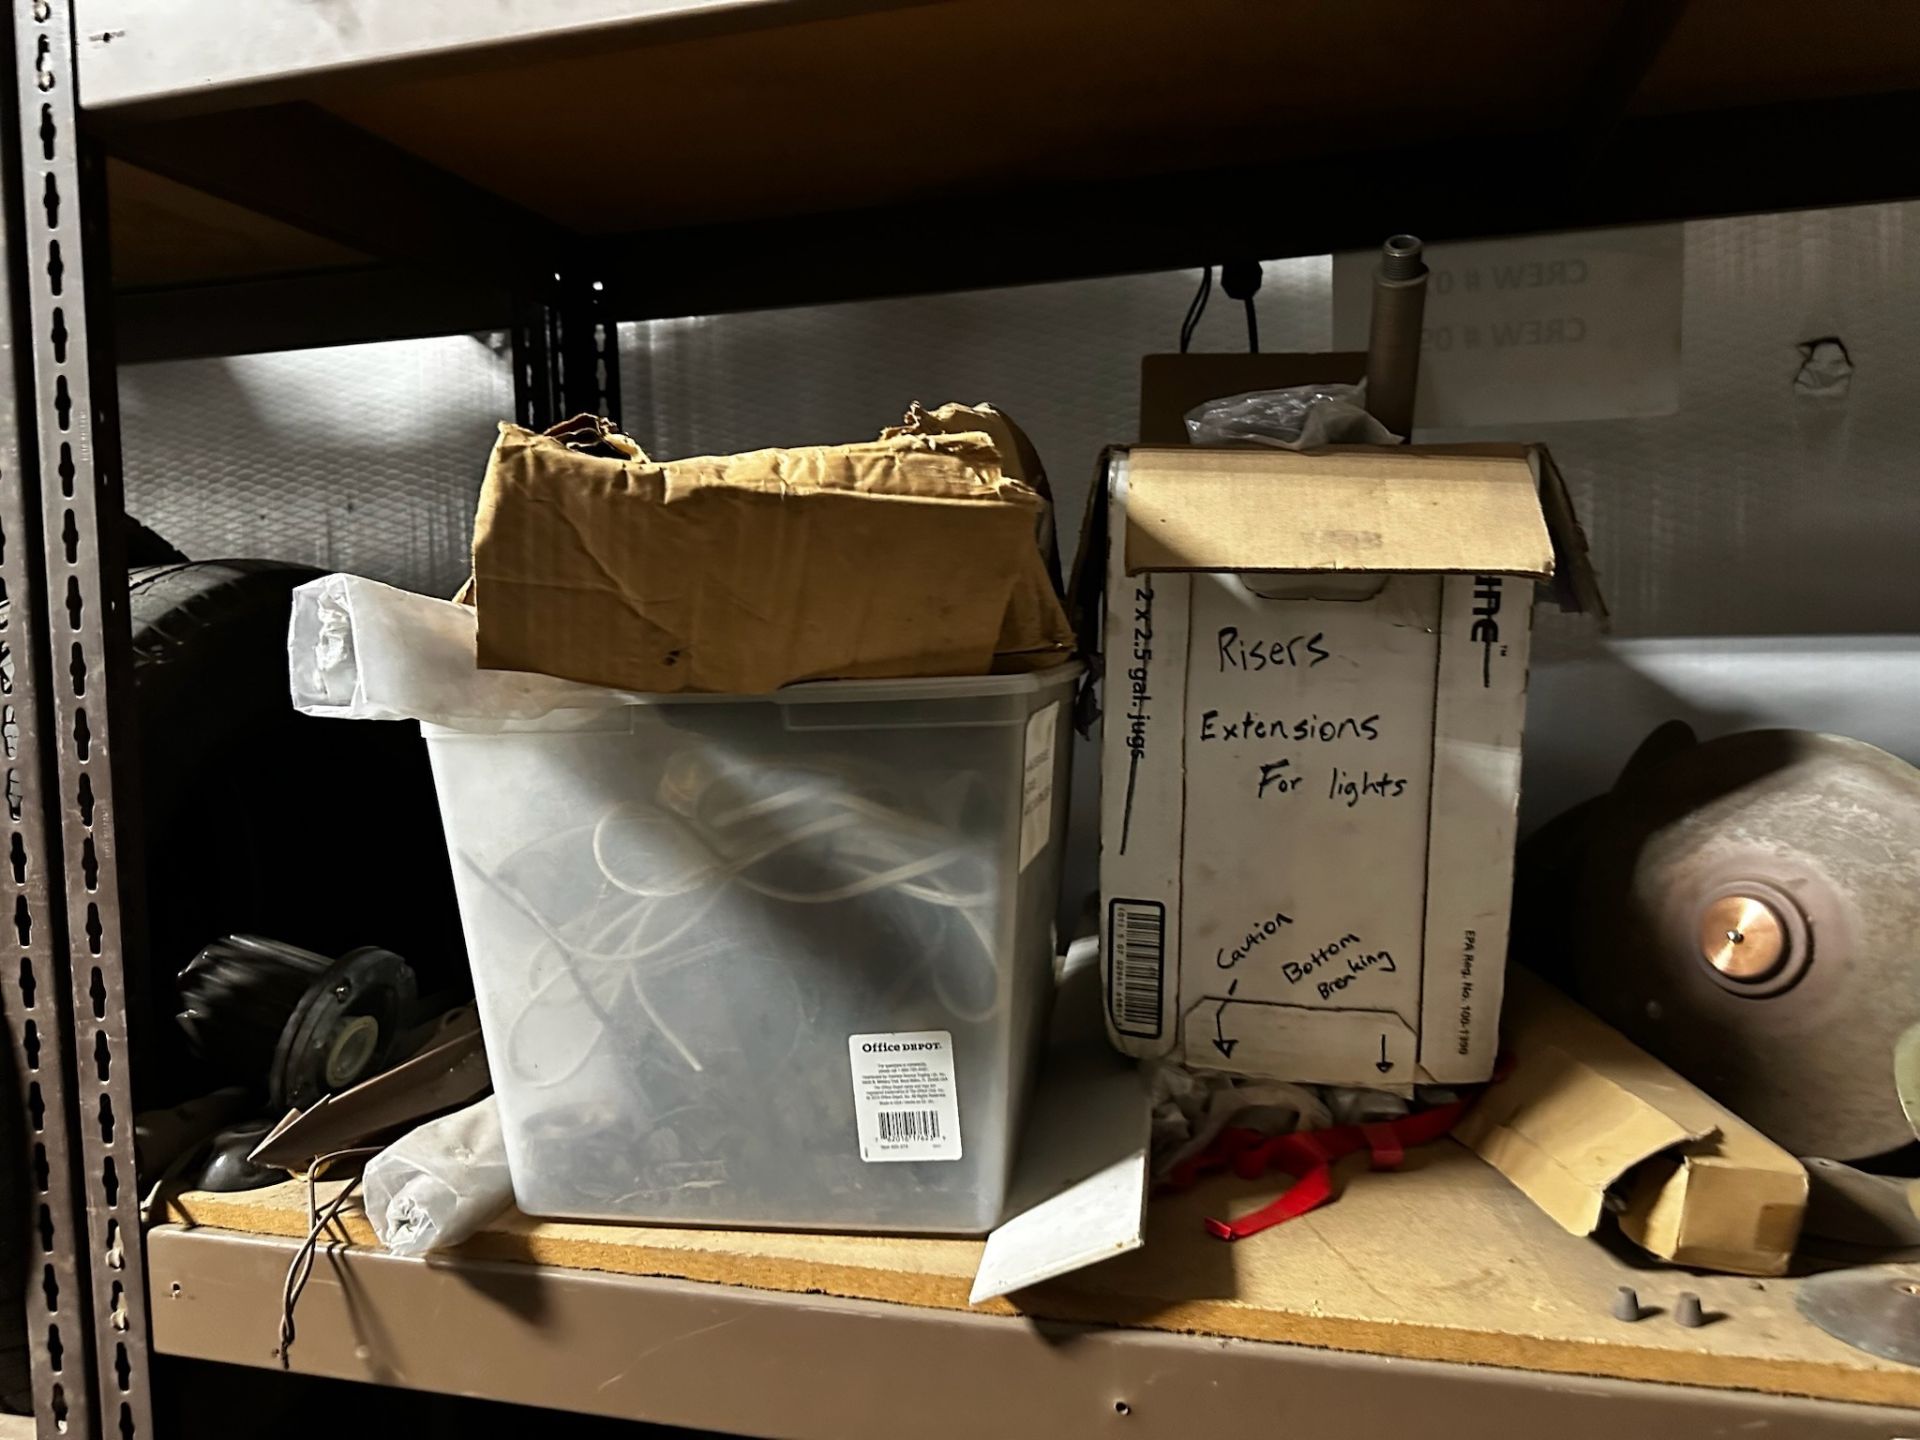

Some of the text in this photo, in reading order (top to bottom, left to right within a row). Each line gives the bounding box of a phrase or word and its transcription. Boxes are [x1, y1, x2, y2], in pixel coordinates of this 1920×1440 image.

[1126, 588, 1154, 759] 2 x 2.5 gal. jugs
[1217, 626, 1331, 673] Risers
[1200, 709, 1380, 742] Extensions
[1257, 758, 1408, 808] For lights
[1217, 912, 1294, 970] Caution
[1281, 933, 1361, 985] Bottom
[1464, 930, 1476, 951] EPA
[1317, 951, 1396, 1000] Breaking
[862, 1042, 901, 1053] Office
